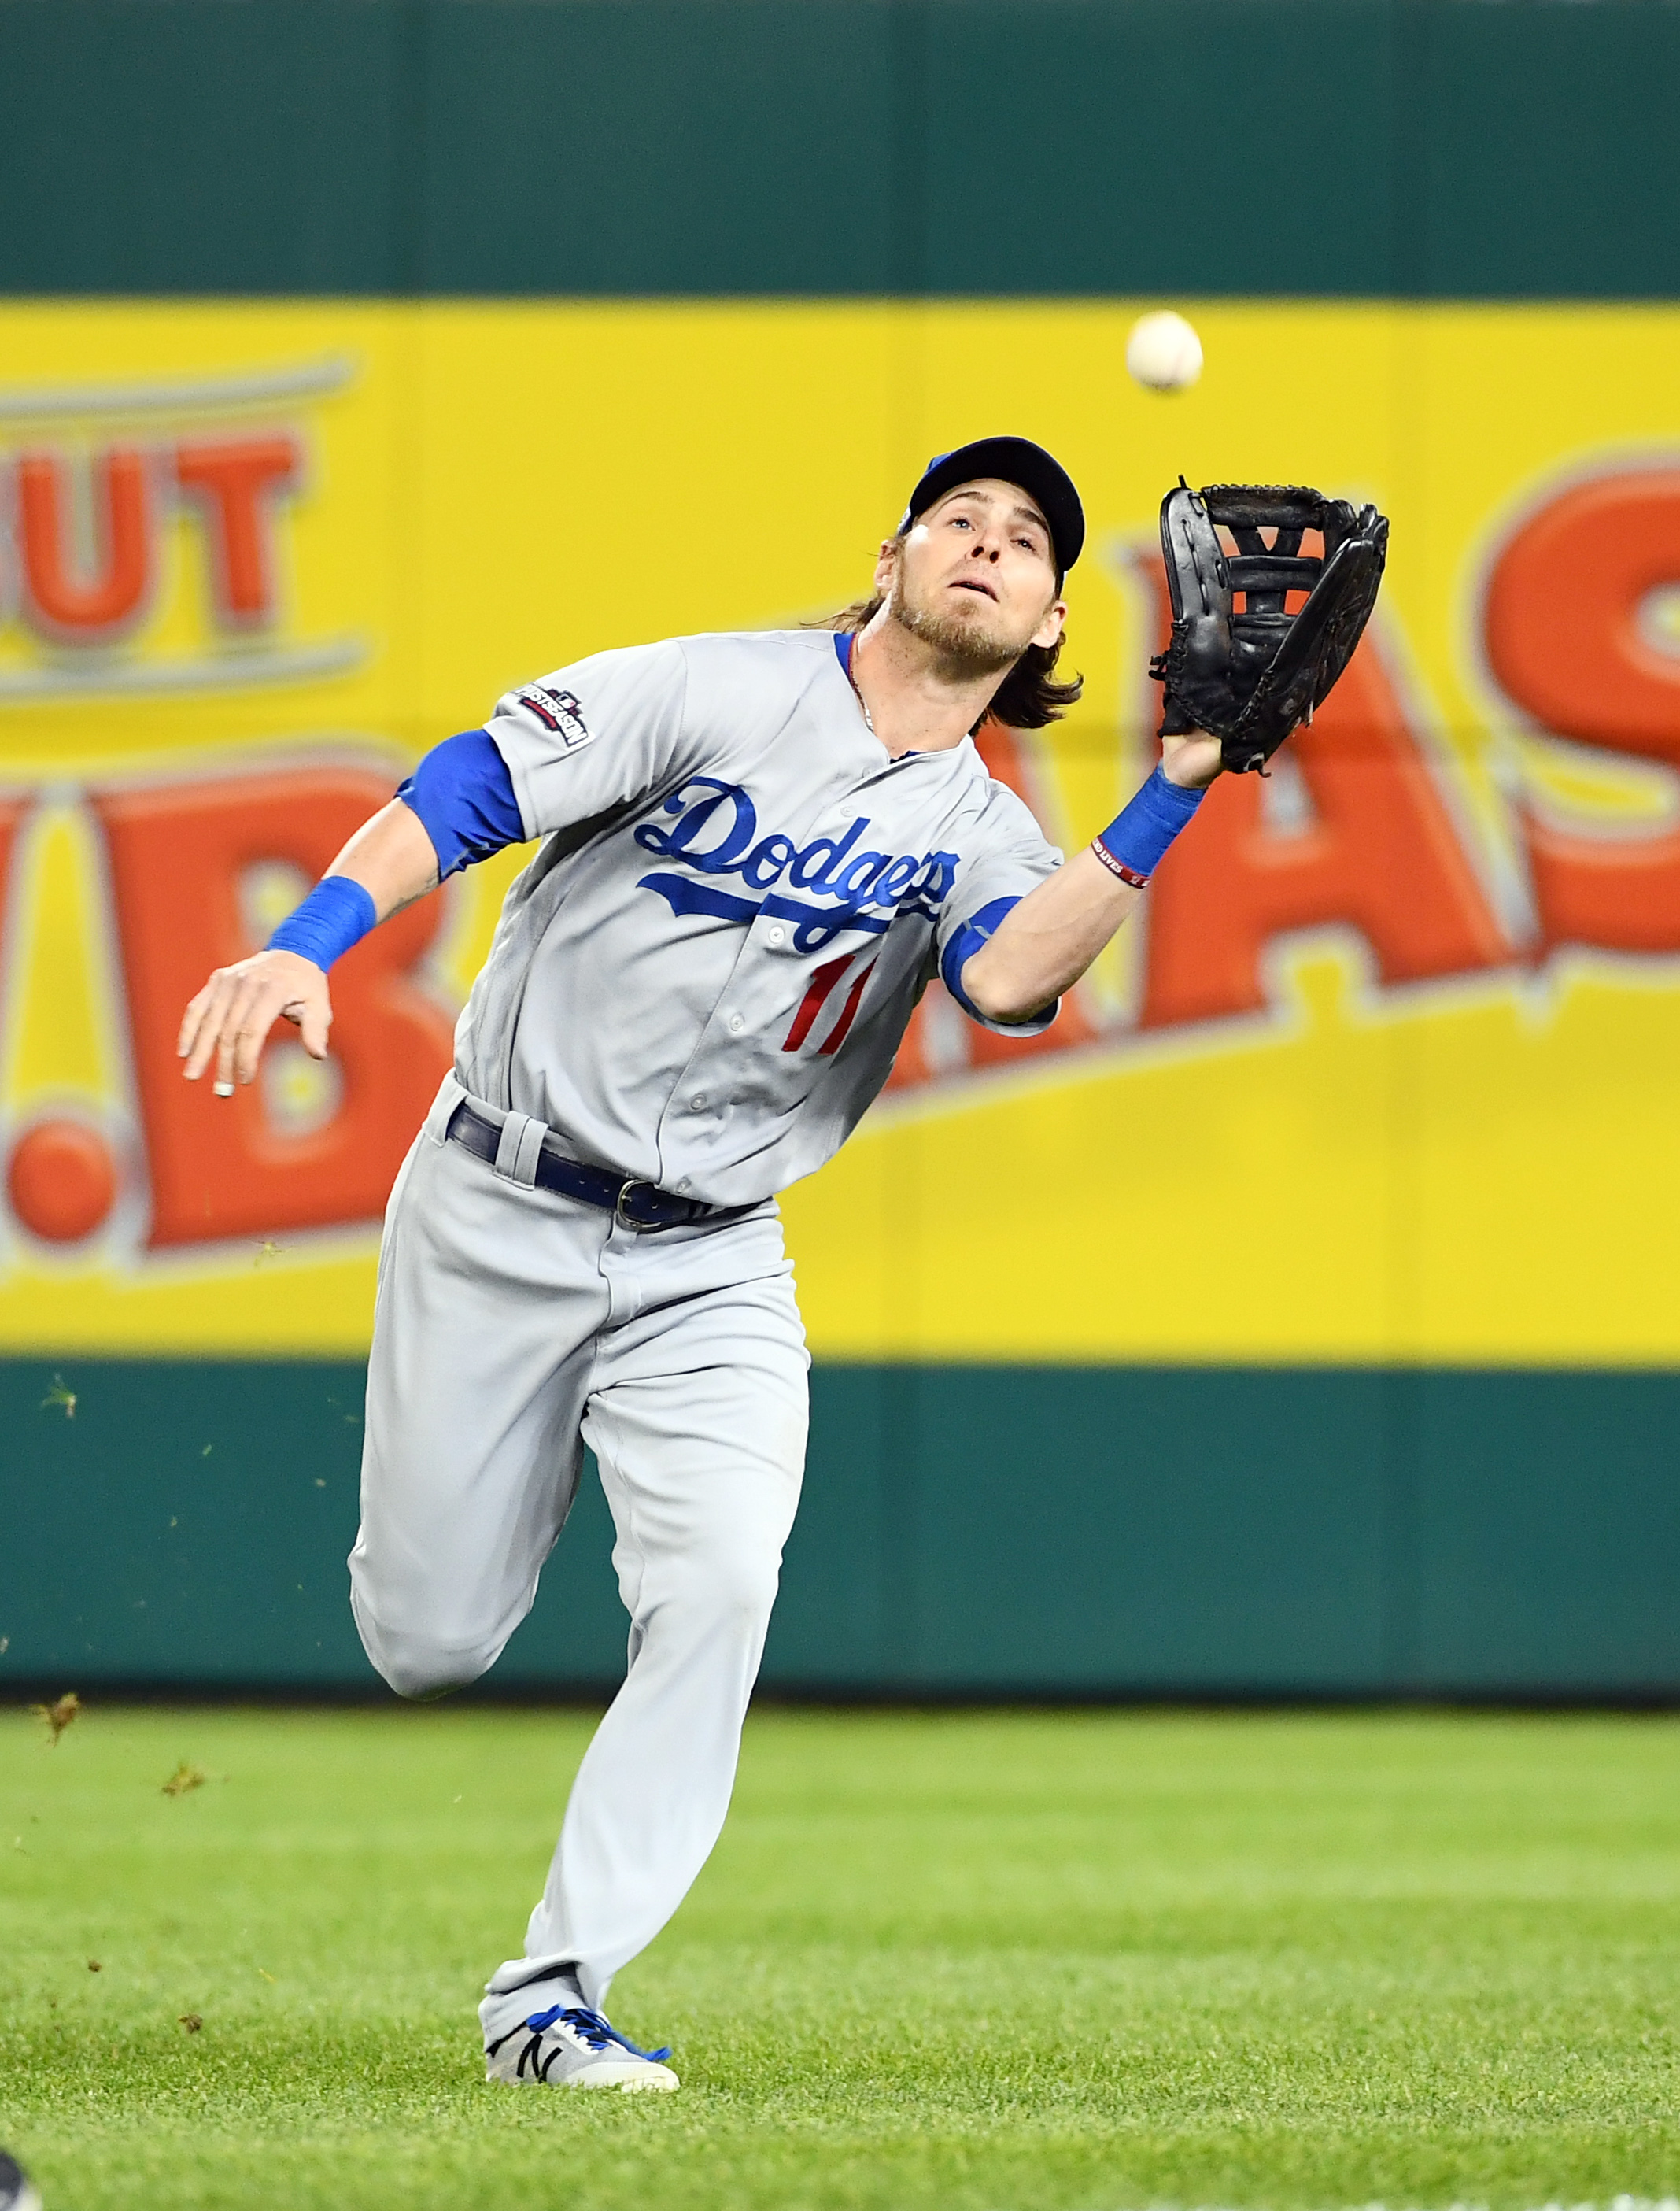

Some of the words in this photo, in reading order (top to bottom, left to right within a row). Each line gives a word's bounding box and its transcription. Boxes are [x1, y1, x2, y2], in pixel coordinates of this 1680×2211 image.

[16, 435, 294, 627] UT
[633, 775, 962, 953] Dodgers
[1099, 849, 1124, 874] LIVES
[781, 953, 878, 1056] 11
